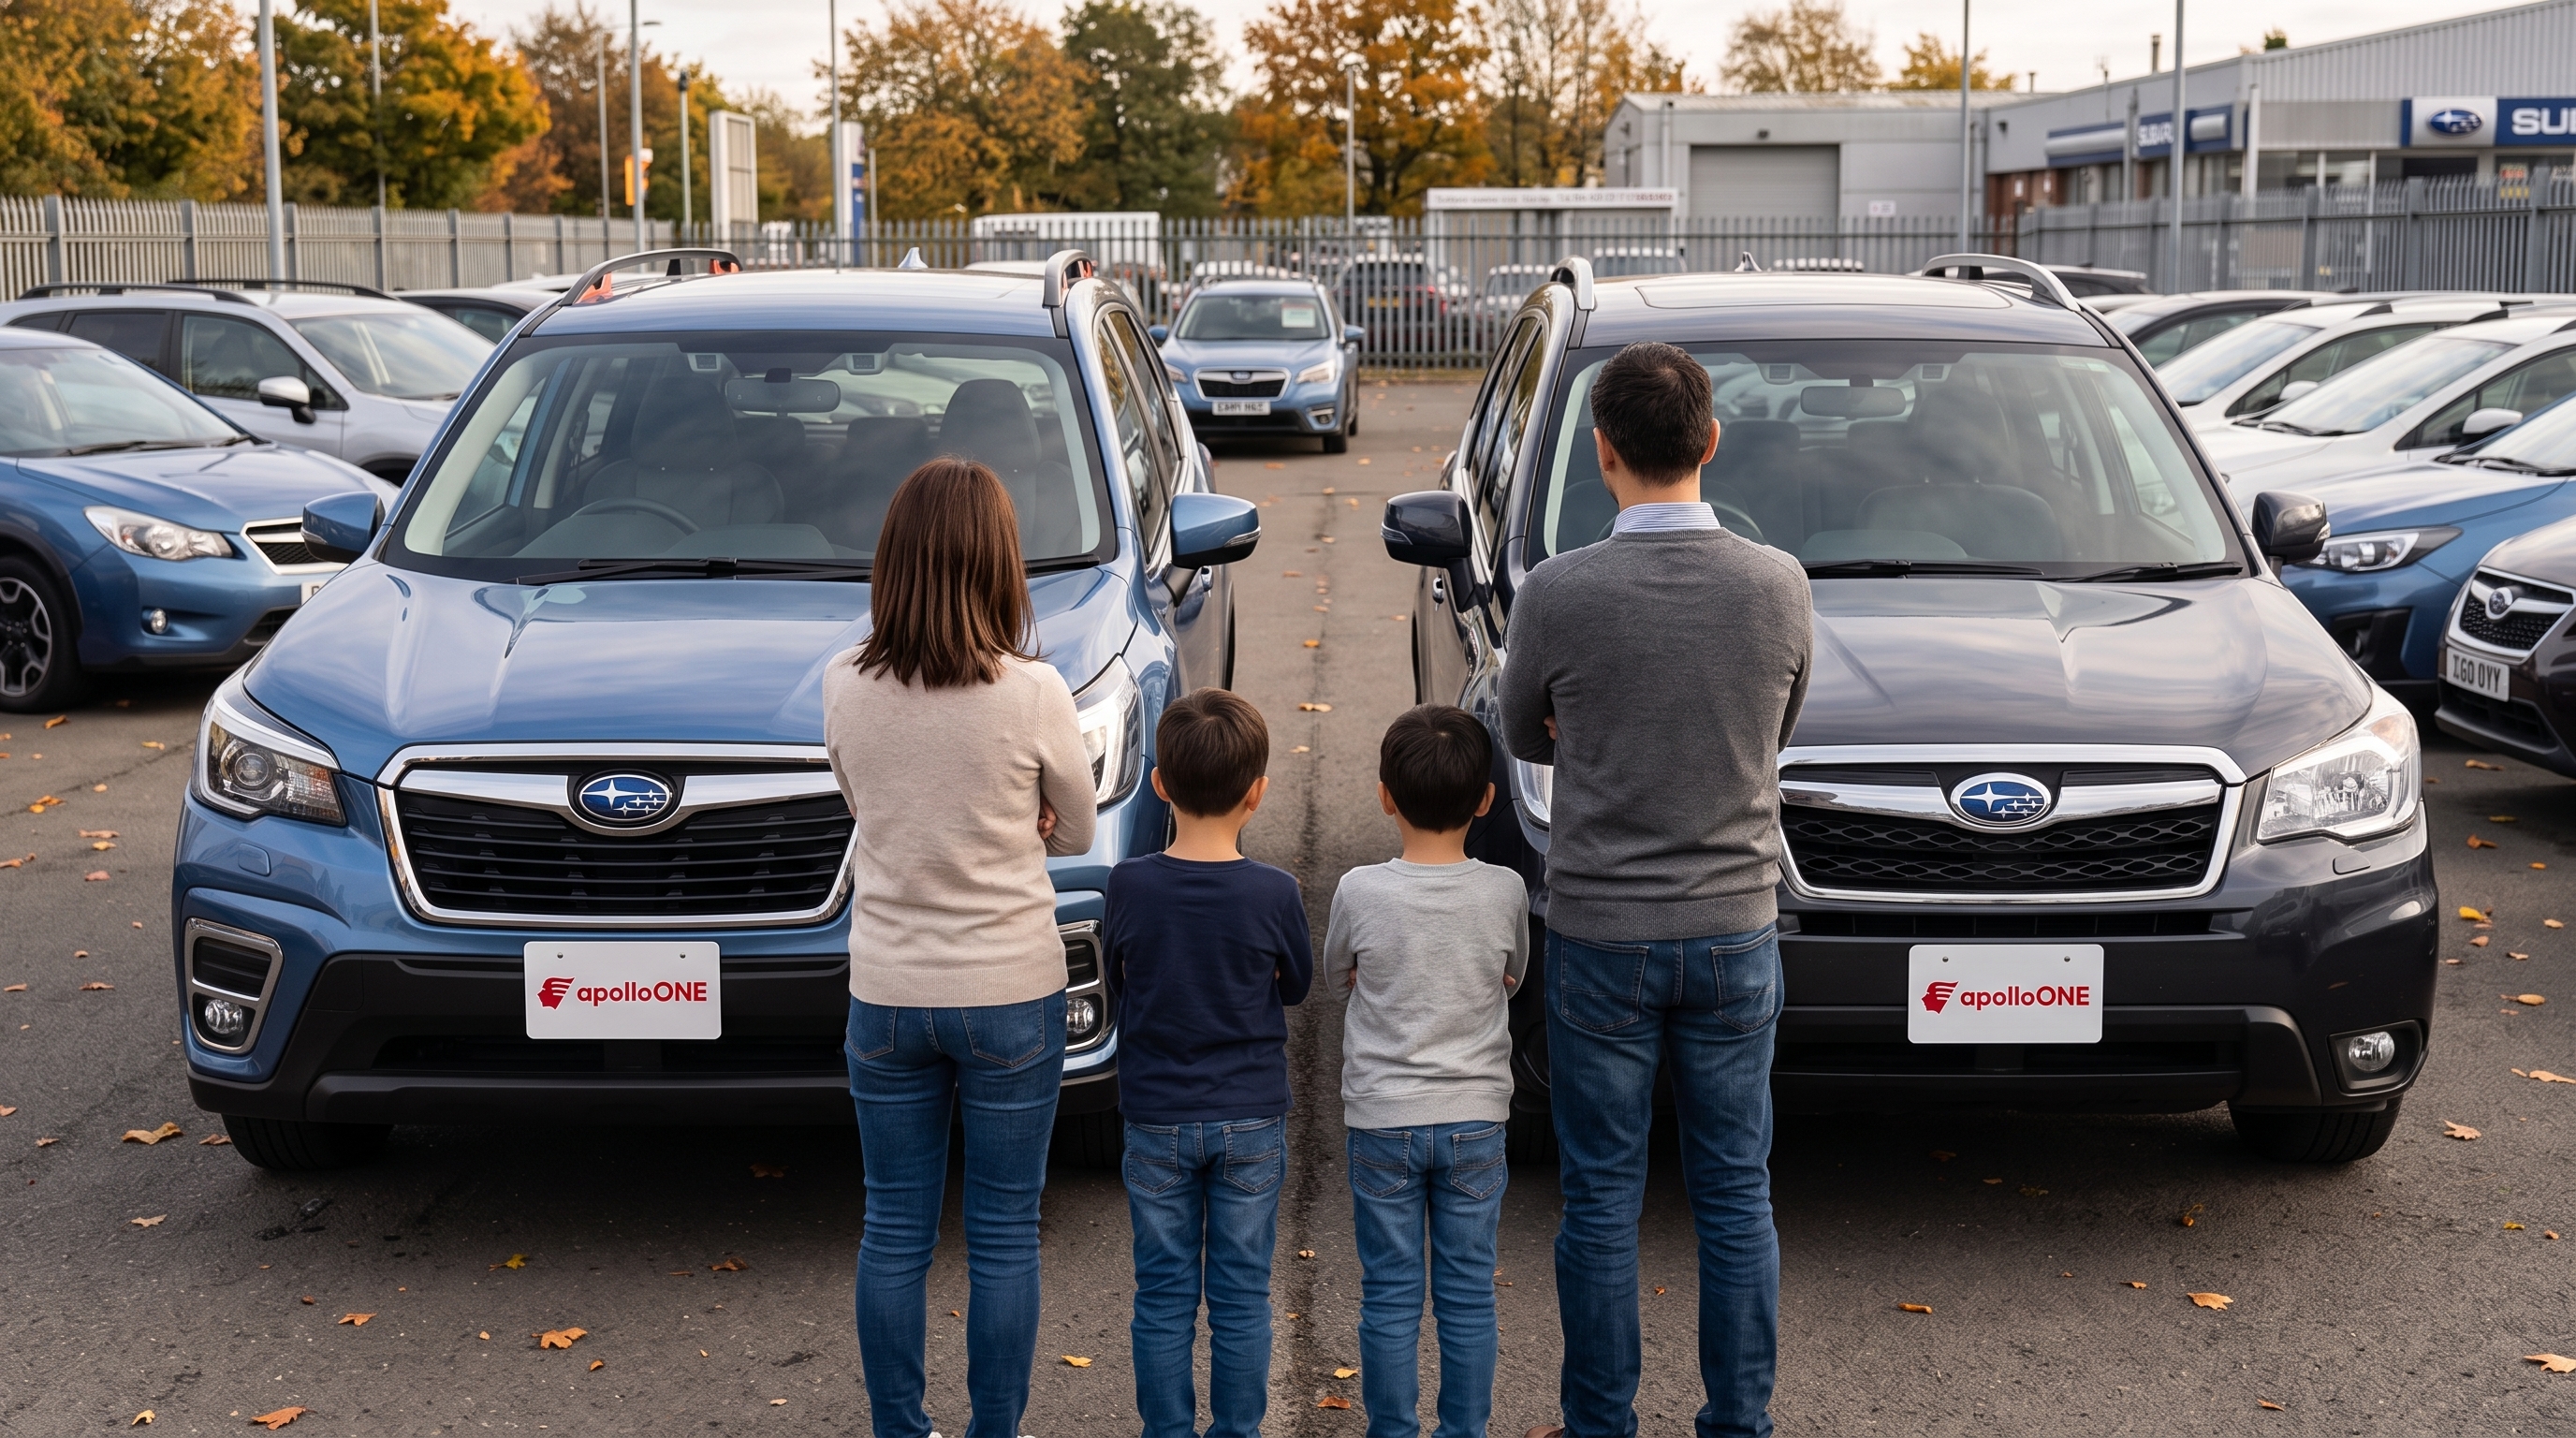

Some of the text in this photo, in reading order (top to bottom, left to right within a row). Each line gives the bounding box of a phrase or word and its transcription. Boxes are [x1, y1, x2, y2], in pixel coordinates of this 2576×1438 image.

[2511, 107, 2576, 135] SU
[577, 981, 707, 1006] apolloONE
[1960, 986, 2089, 1010] apolloONE
